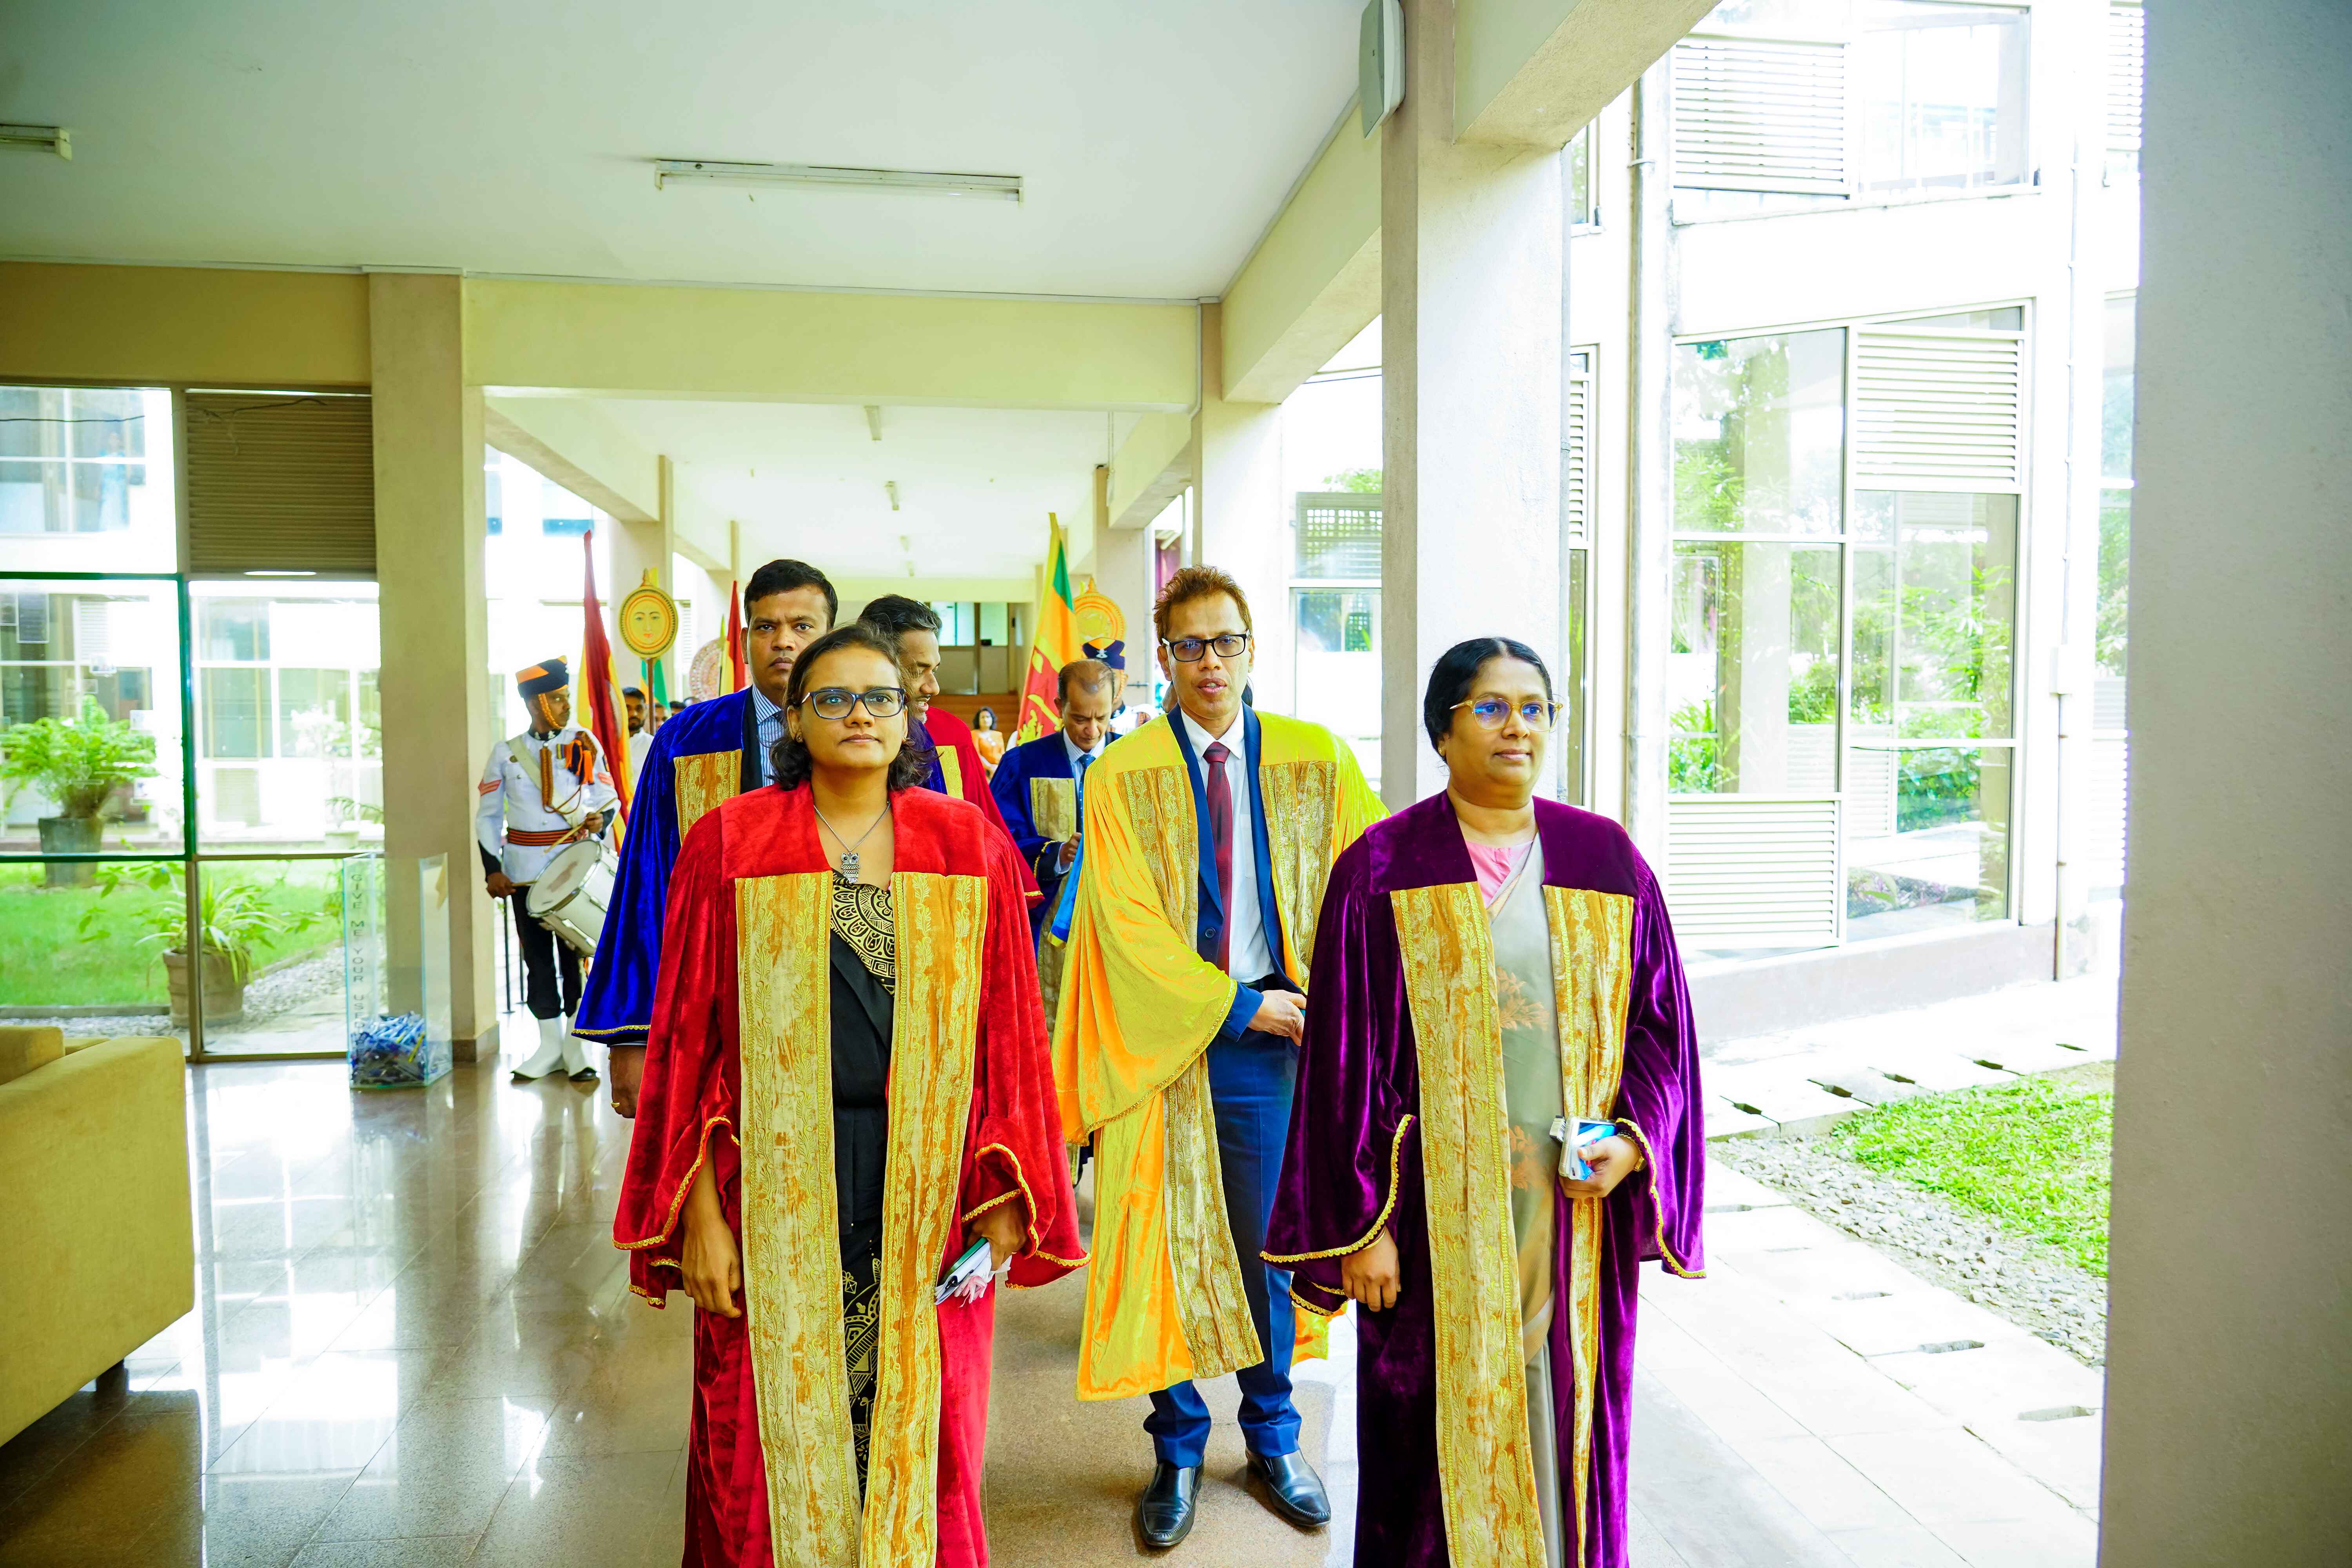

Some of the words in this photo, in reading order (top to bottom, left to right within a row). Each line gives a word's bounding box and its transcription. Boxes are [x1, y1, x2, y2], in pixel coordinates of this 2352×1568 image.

[352, 874, 363, 909] GIVE
[351, 920, 364, 936] ME
[353, 947, 364, 982] YOUR
